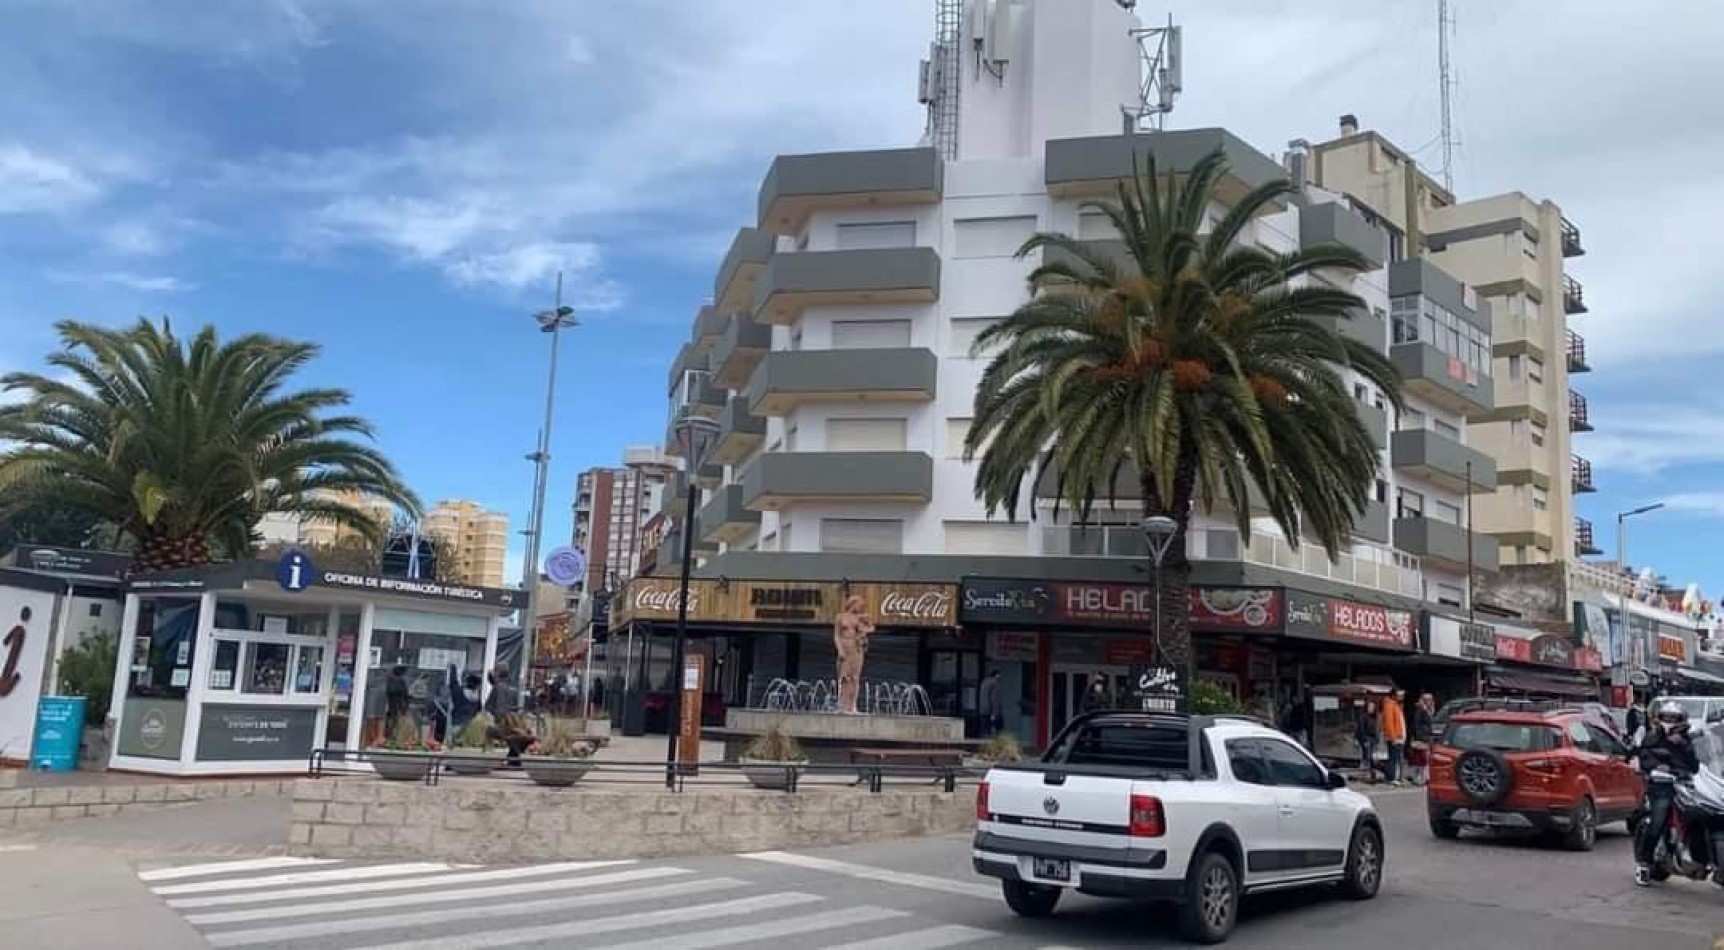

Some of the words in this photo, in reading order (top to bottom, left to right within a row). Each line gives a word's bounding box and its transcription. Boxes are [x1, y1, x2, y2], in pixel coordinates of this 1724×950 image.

[324, 572, 363, 586] OFICINA
[365, 577, 379, 588] DE
[1334, 603, 1385, 632] HELADOS
